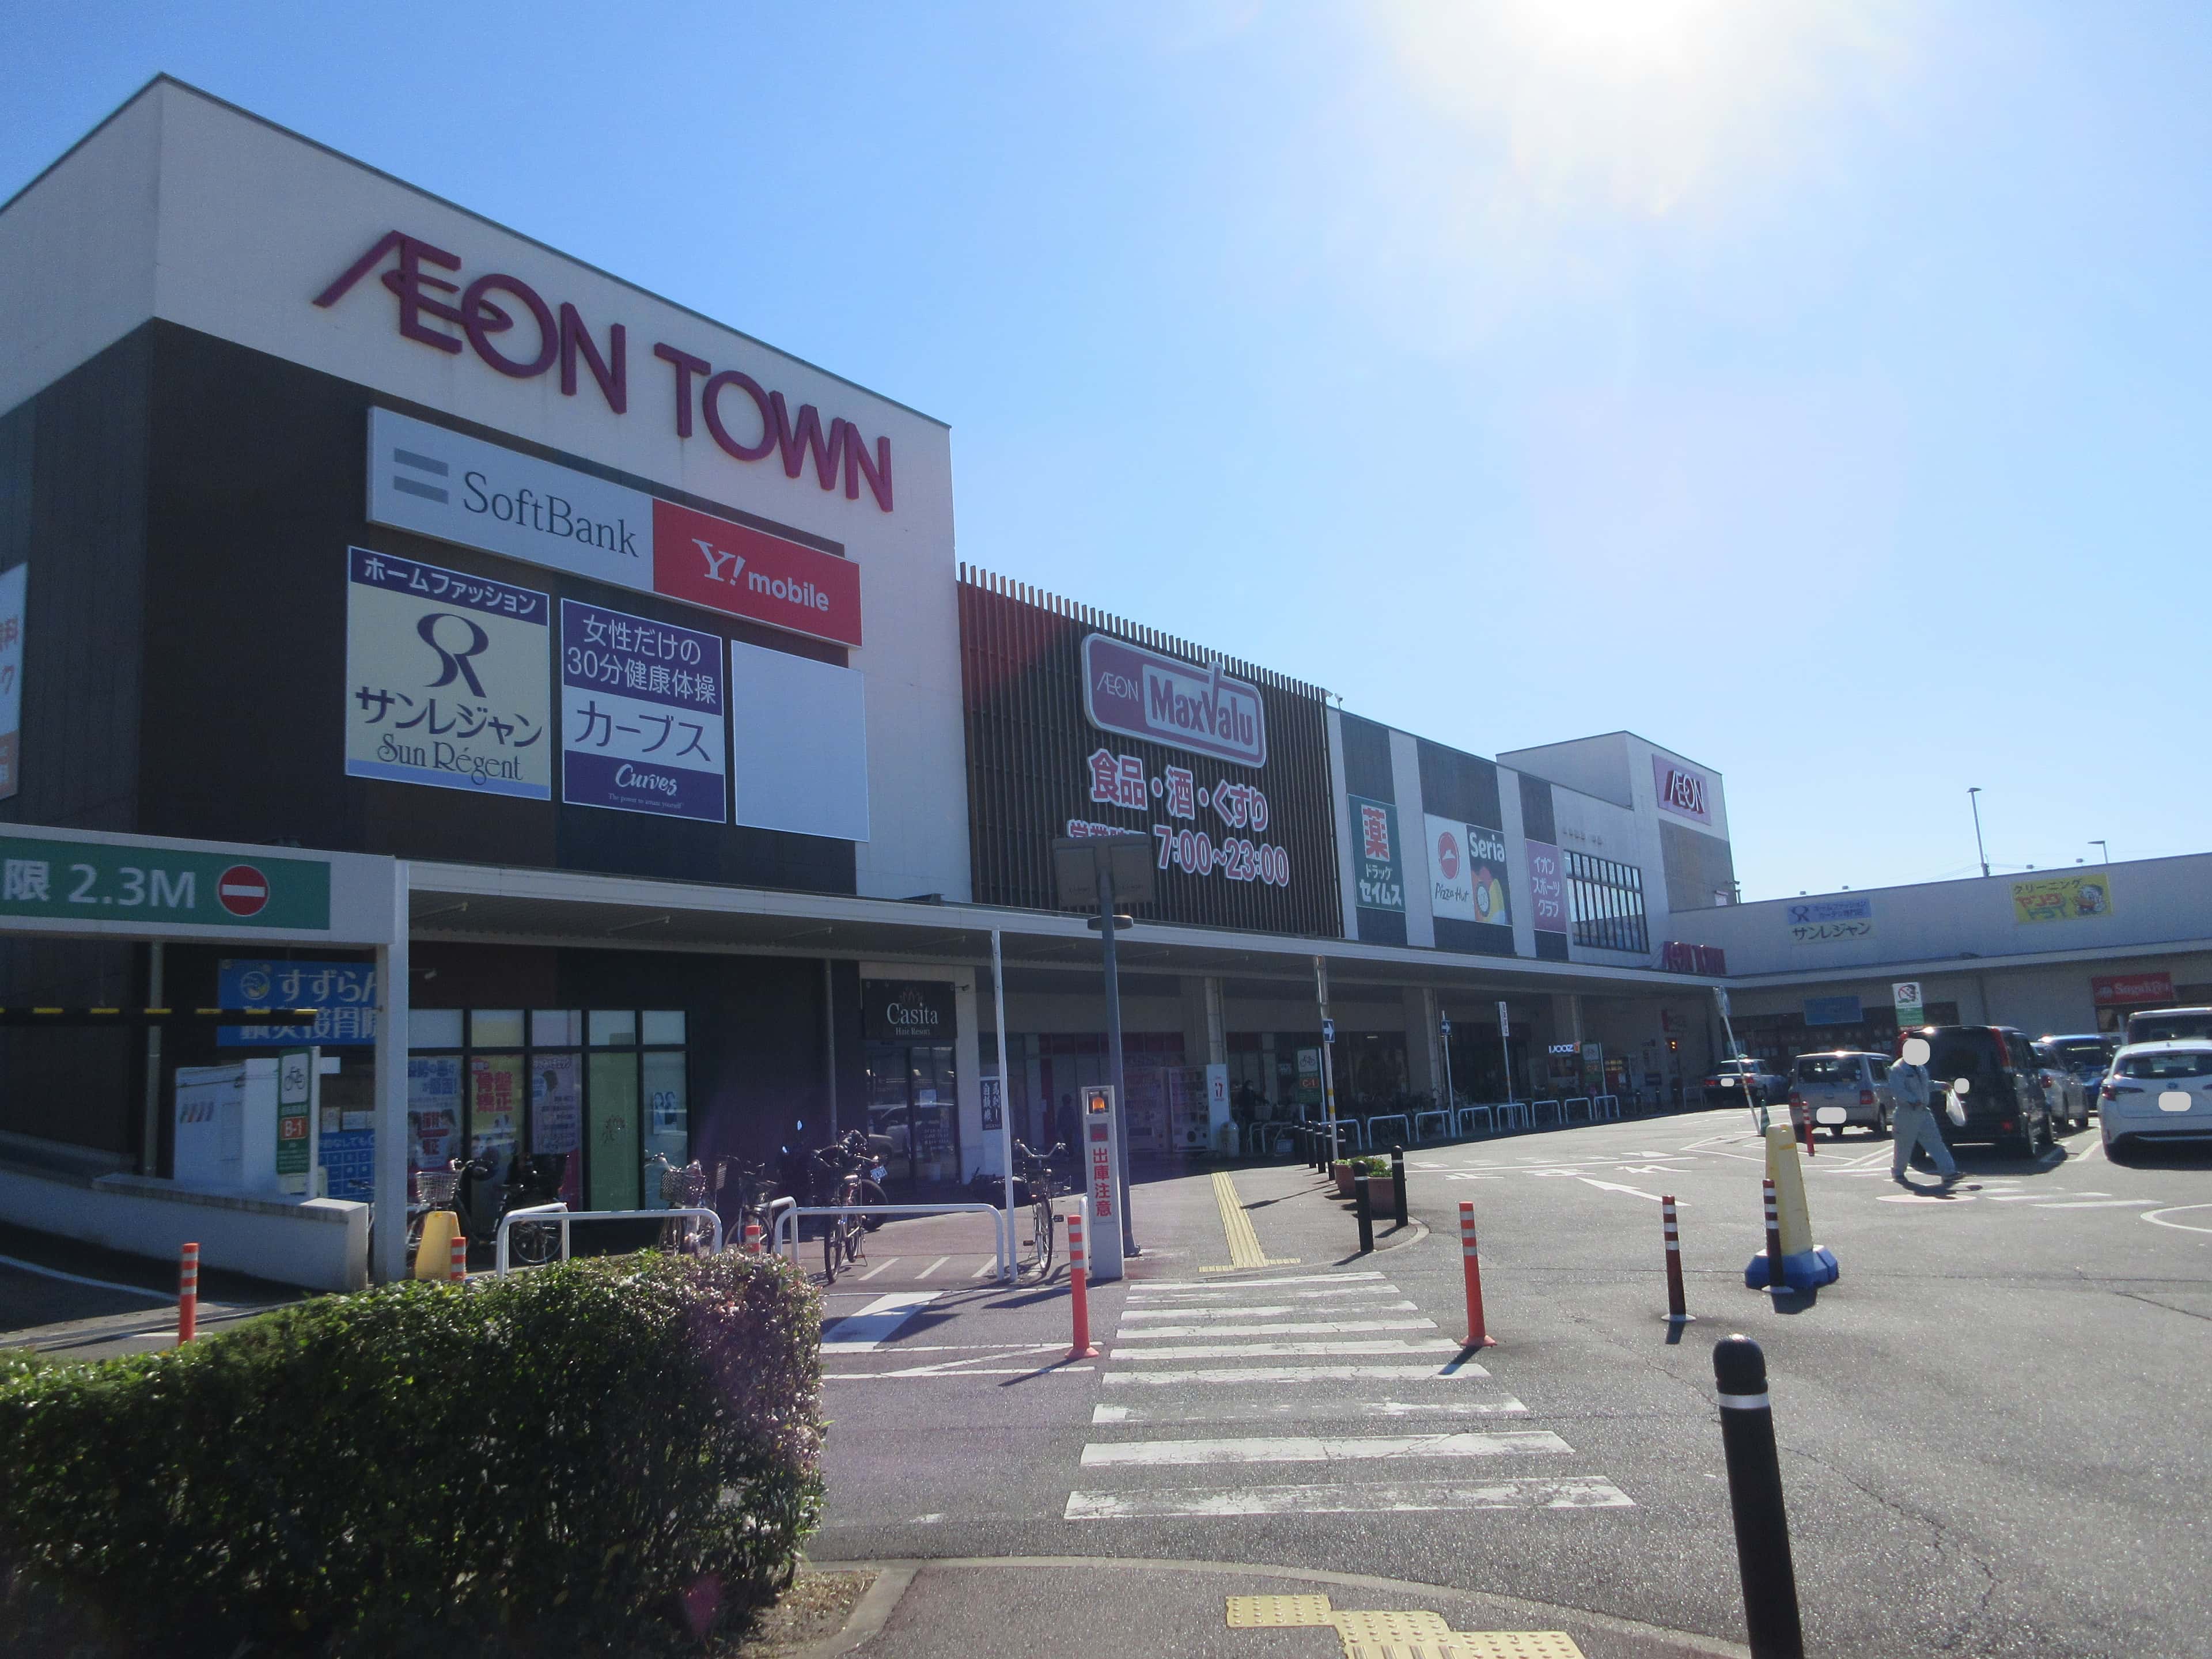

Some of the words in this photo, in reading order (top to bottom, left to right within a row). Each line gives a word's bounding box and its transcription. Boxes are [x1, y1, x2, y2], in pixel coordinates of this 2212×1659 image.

[654, 342, 893, 512] TOWN
[464, 471, 638, 558] SoftBank
[364, 557, 536, 614] ホームファッション
[582, 614, 701, 665] 女性だけの
[567, 653, 717, 704] 30分健康体操
[355, 685, 543, 748] サンレジャン
[1149, 661, 1254, 747] MaxValu
[574, 700, 711, 762] カーブス
[377, 733, 427, 767] Sun
[432, 741, 524, 785] Régent
[615, 763, 678, 796] Curves
[1363, 807, 1389, 860] 薬
[1469, 832, 1505, 862] Seria
[3, 859, 50, 900] 限
[69, 864, 195, 908] 2.3M
[1366, 863, 1393, 881] ドラッグ
[1532, 876, 1560, 897] スポーツ
[1534, 856, 1555, 874] イオン
[1359, 878, 1402, 907] セイムス
[1538, 899, 1559, 918] クラブ
[1792, 922, 1871, 940] サンレジャン
[887, 1002, 939, 1025] Casita
[896, 1027, 910, 1035] Hair
[1093, 1147, 1112, 1217] 出庫注意
